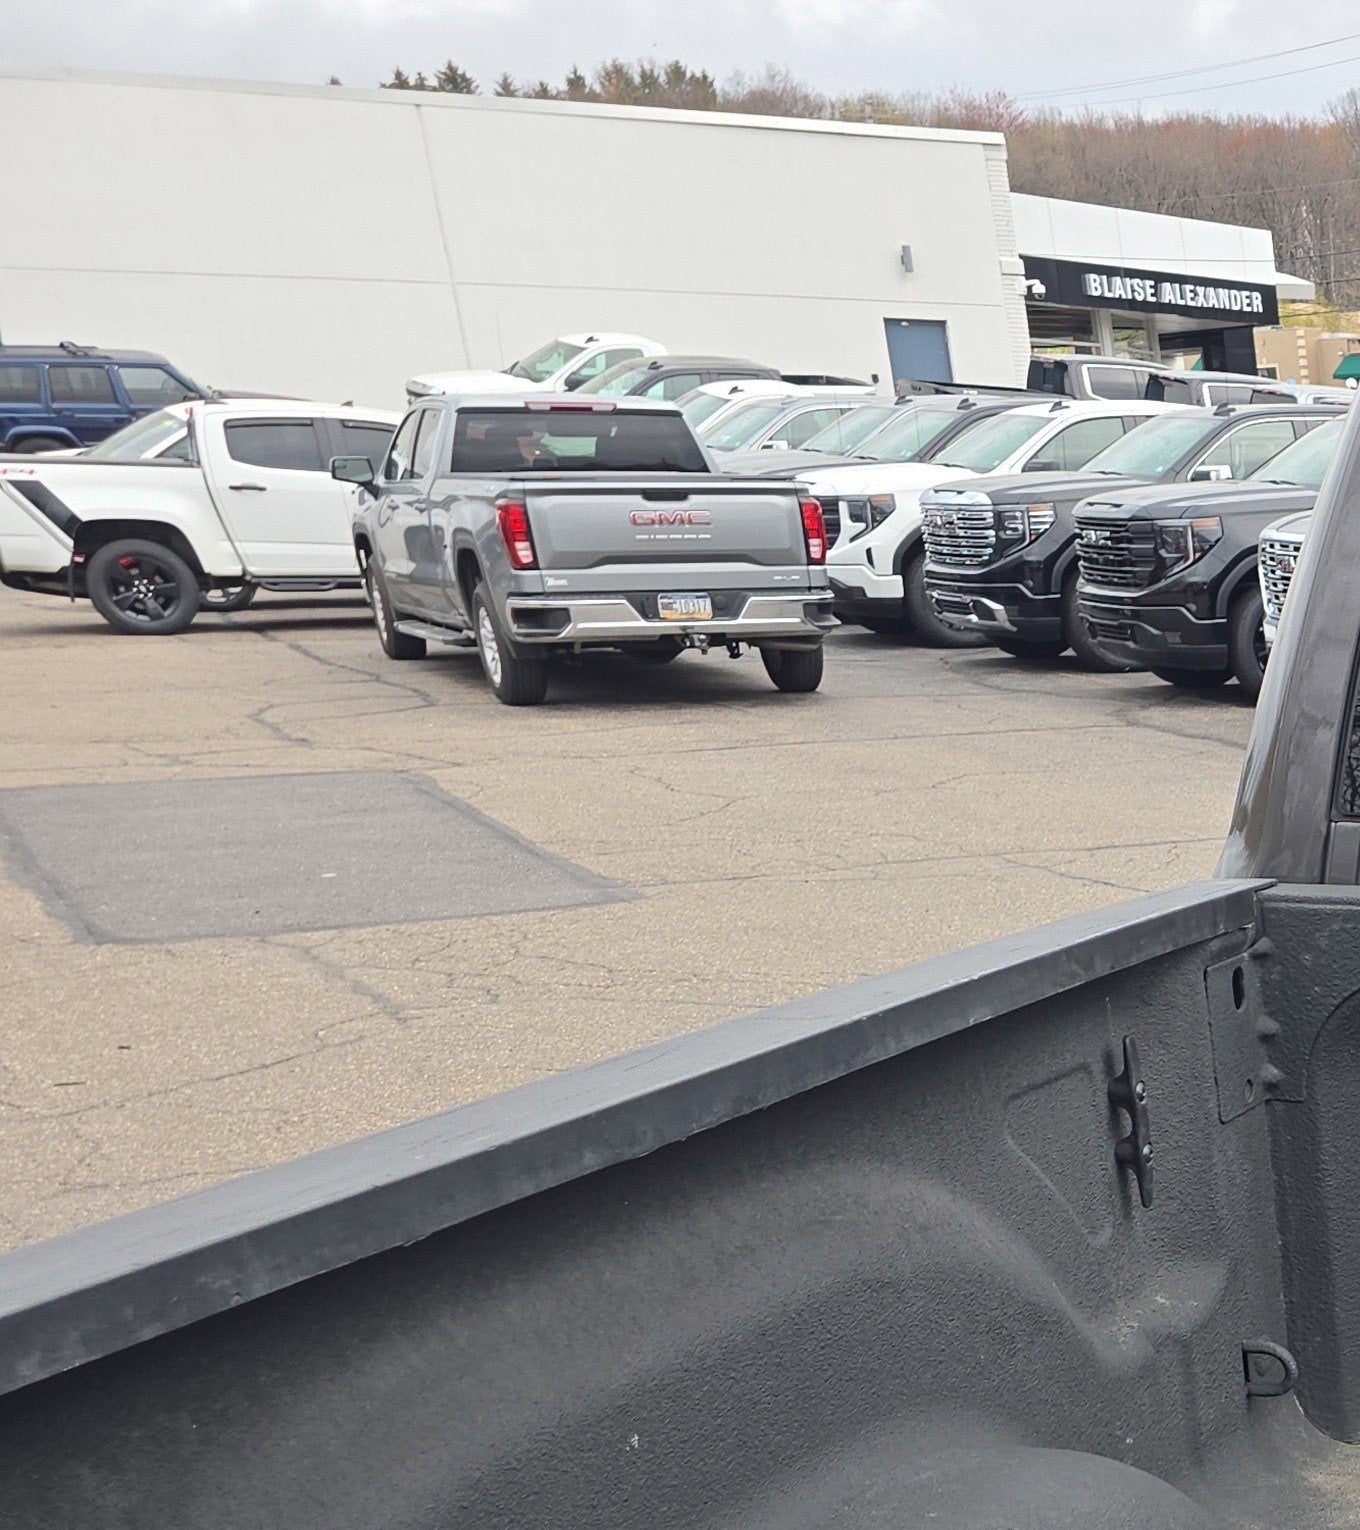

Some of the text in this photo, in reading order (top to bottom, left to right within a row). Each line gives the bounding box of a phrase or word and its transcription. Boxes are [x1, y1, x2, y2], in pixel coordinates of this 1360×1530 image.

[1087, 273, 1264, 313] BLAISE ALEXANDER
[629, 510, 713, 527] GMC
